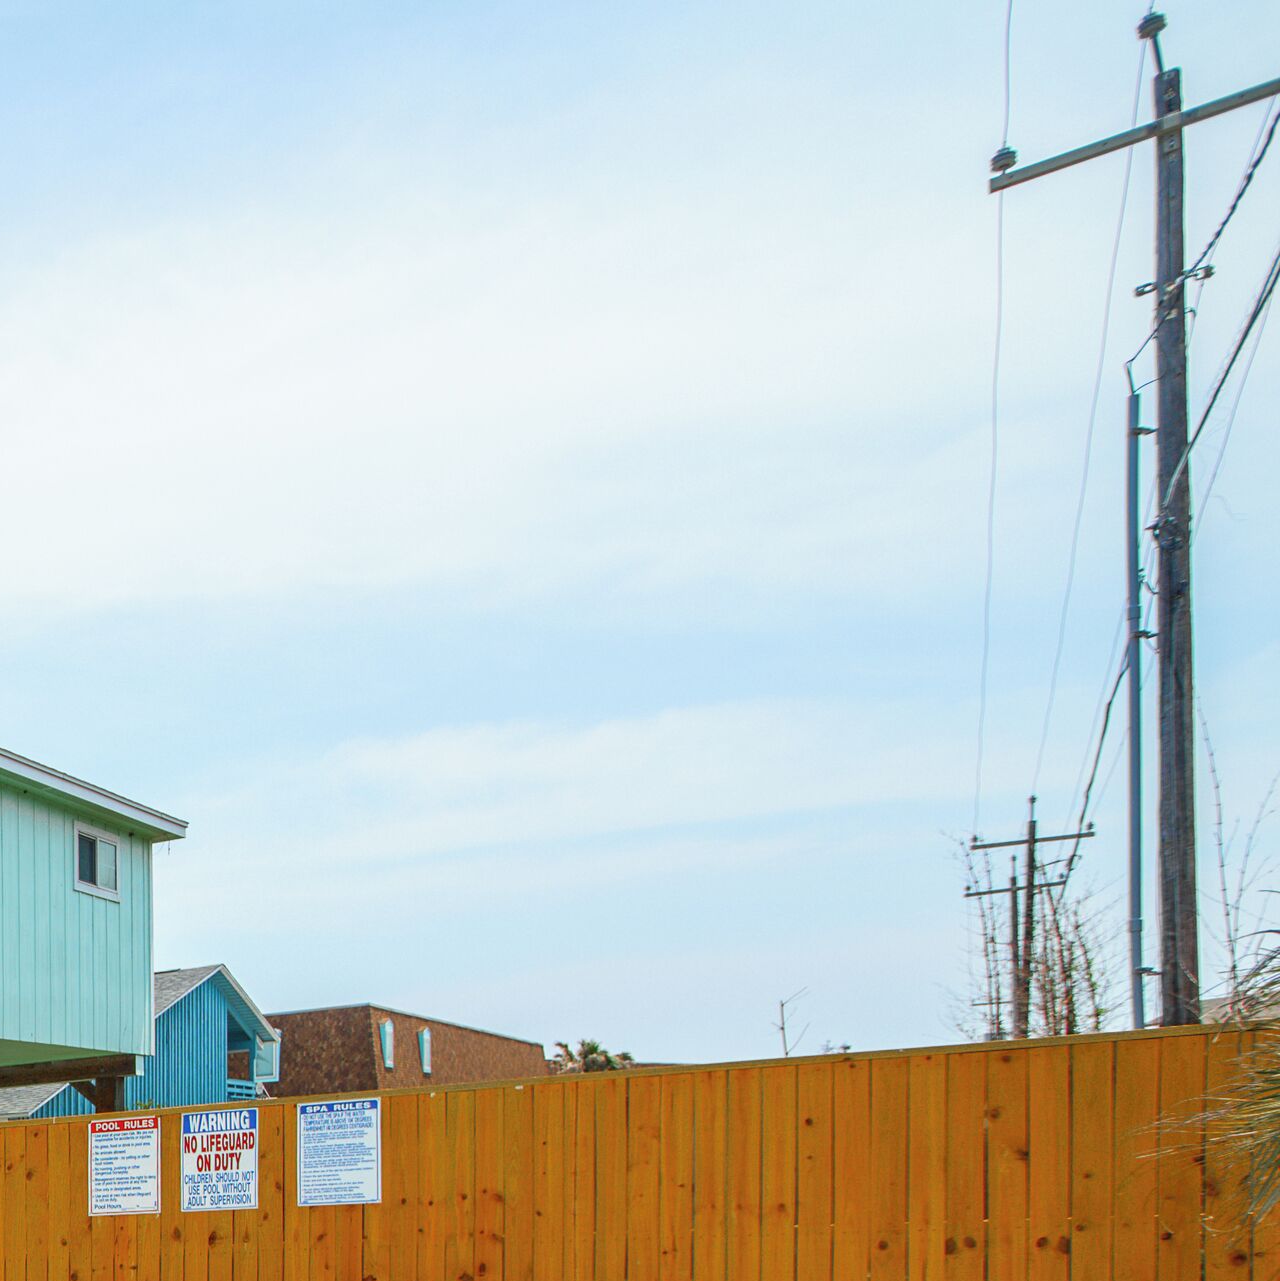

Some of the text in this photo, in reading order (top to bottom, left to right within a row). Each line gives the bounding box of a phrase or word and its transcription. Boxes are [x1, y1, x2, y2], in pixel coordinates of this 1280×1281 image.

[334, 1102, 371, 1111] RULES
[96, 1119, 154, 1131] POOL RULES
[189, 1111, 250, 1132] WARNING
[184, 1132, 254, 1153] NO LIFEGUARD
[197, 1152, 241, 1172] ON DUTY
[185, 1171, 254, 1184] CHILDREN SHOULD NOT
[189, 1183, 250, 1195] USE POOL WITHOUT
[188, 1194, 251, 1206] ADULT SUPERVISION
